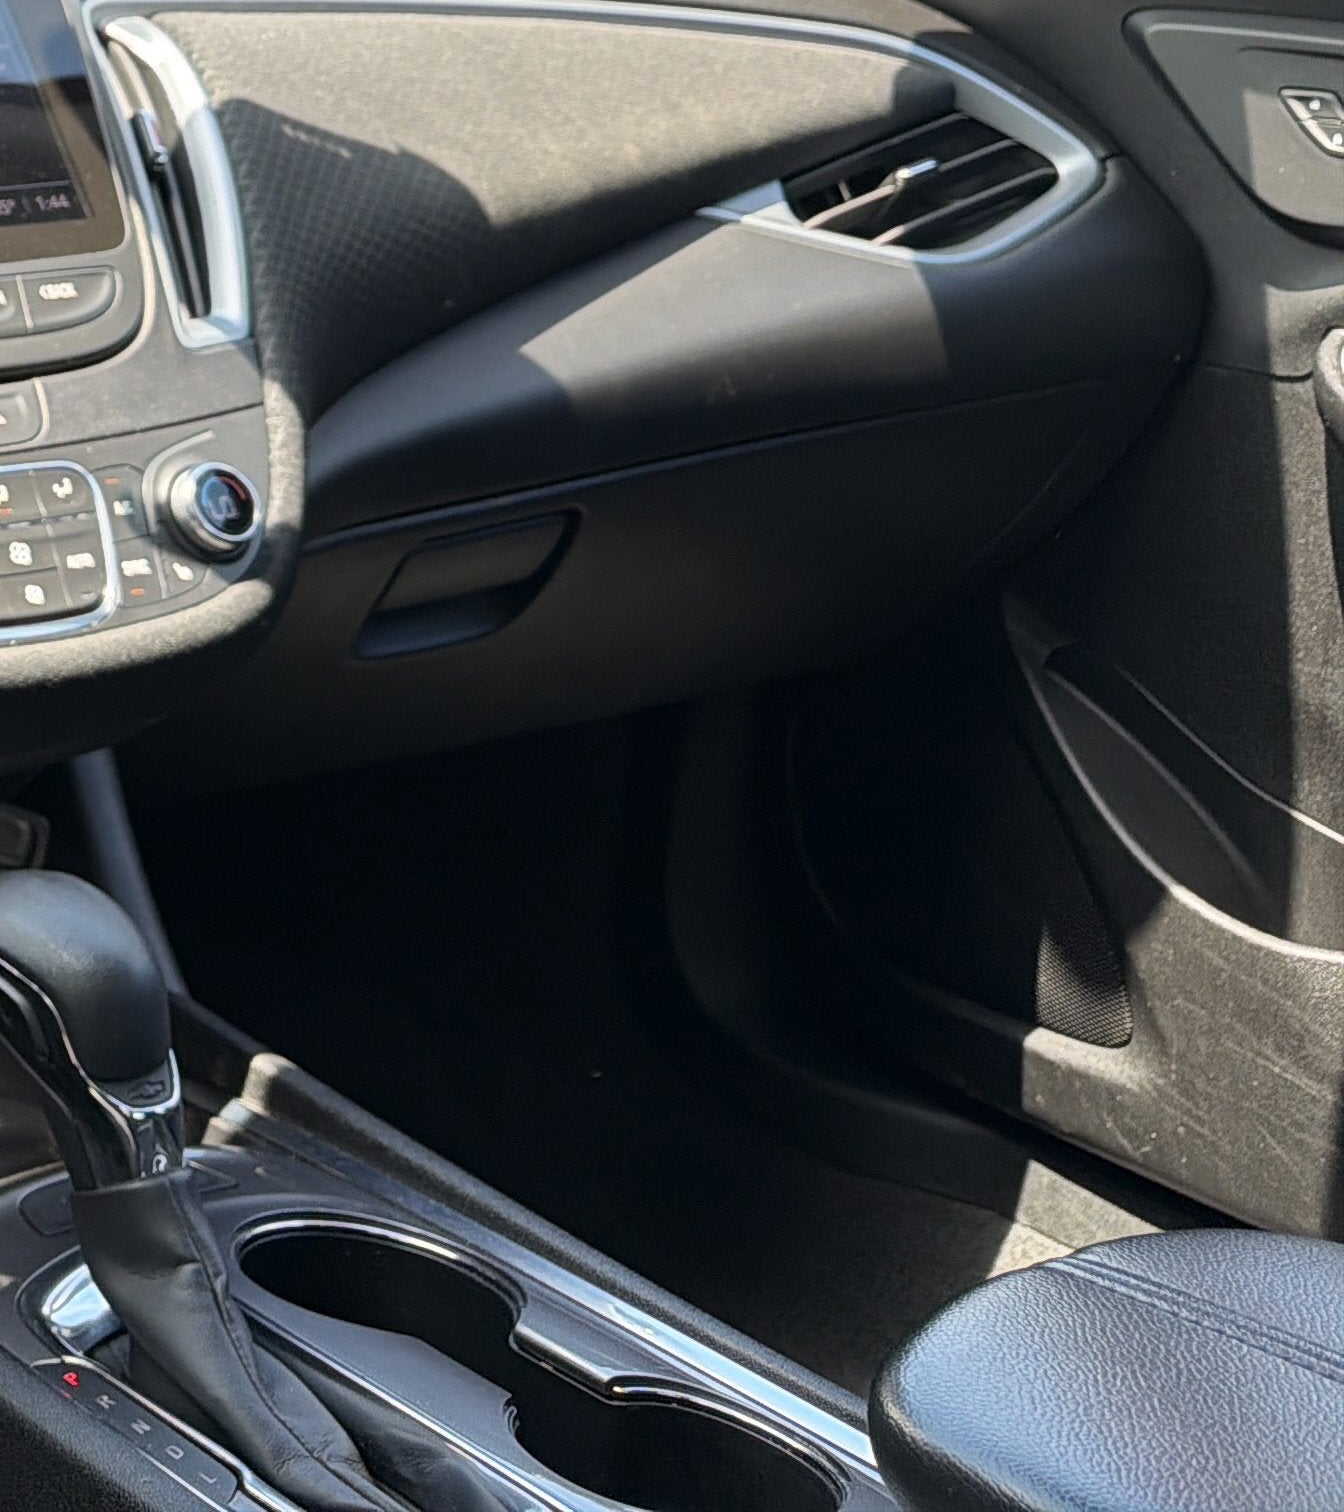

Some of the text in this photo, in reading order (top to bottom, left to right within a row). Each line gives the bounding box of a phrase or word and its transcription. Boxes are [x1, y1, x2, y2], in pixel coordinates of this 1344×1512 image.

[35, 193, 71, 211] 1:44
[62, 1371, 80, 1388] P
[96, 1394, 117, 1410] R
[130, 1418, 152, 1436] N
[164, 1444, 185, 1461] D
